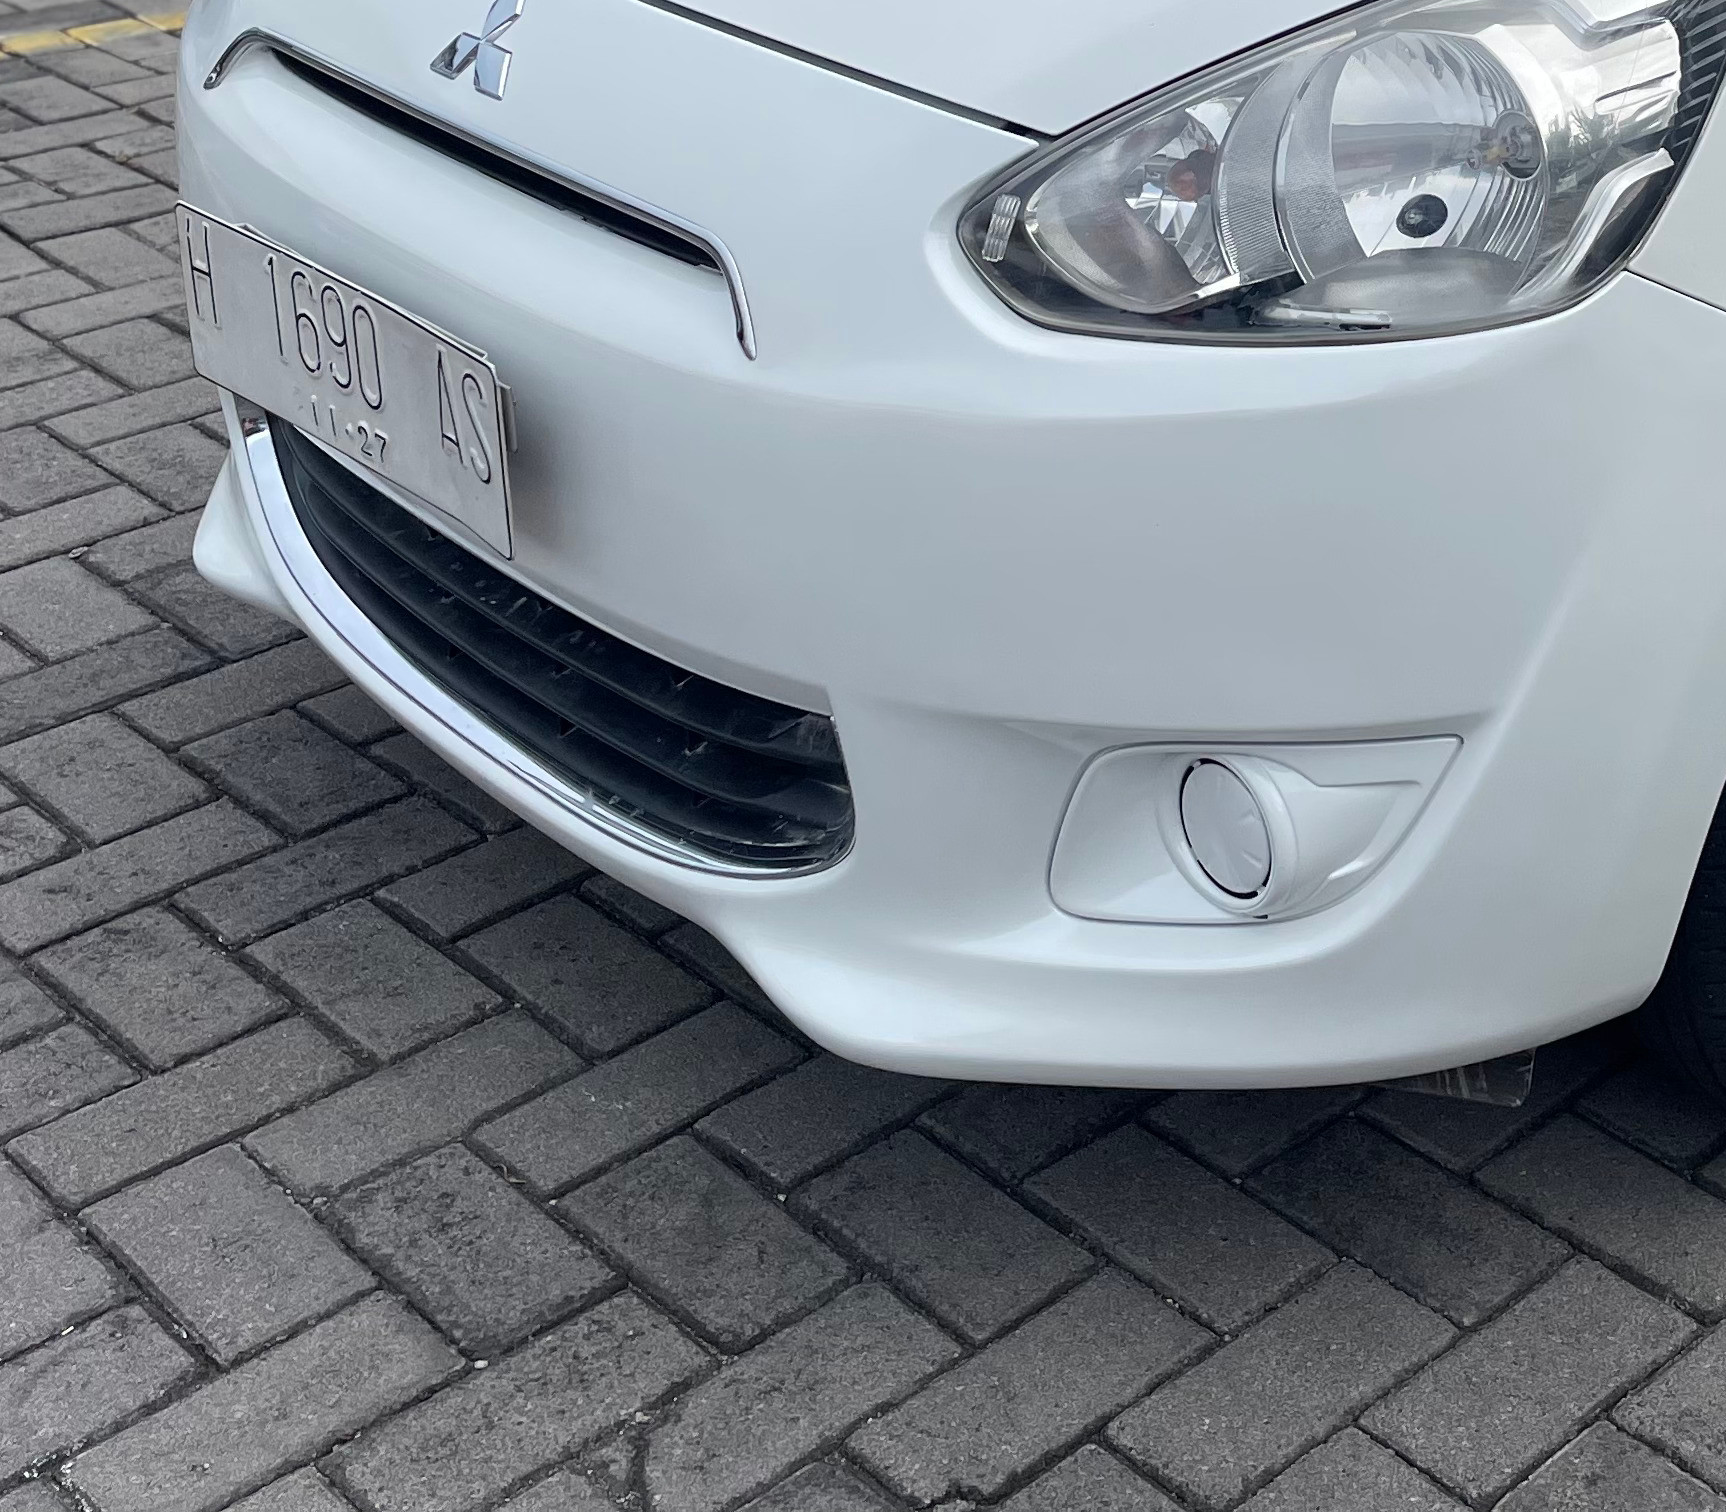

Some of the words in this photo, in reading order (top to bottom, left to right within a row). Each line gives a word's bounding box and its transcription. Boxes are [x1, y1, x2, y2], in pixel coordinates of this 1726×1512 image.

[186, 216, 222, 328] H
[265, 253, 384, 411] 1690
[436, 346, 492, 485] AS
